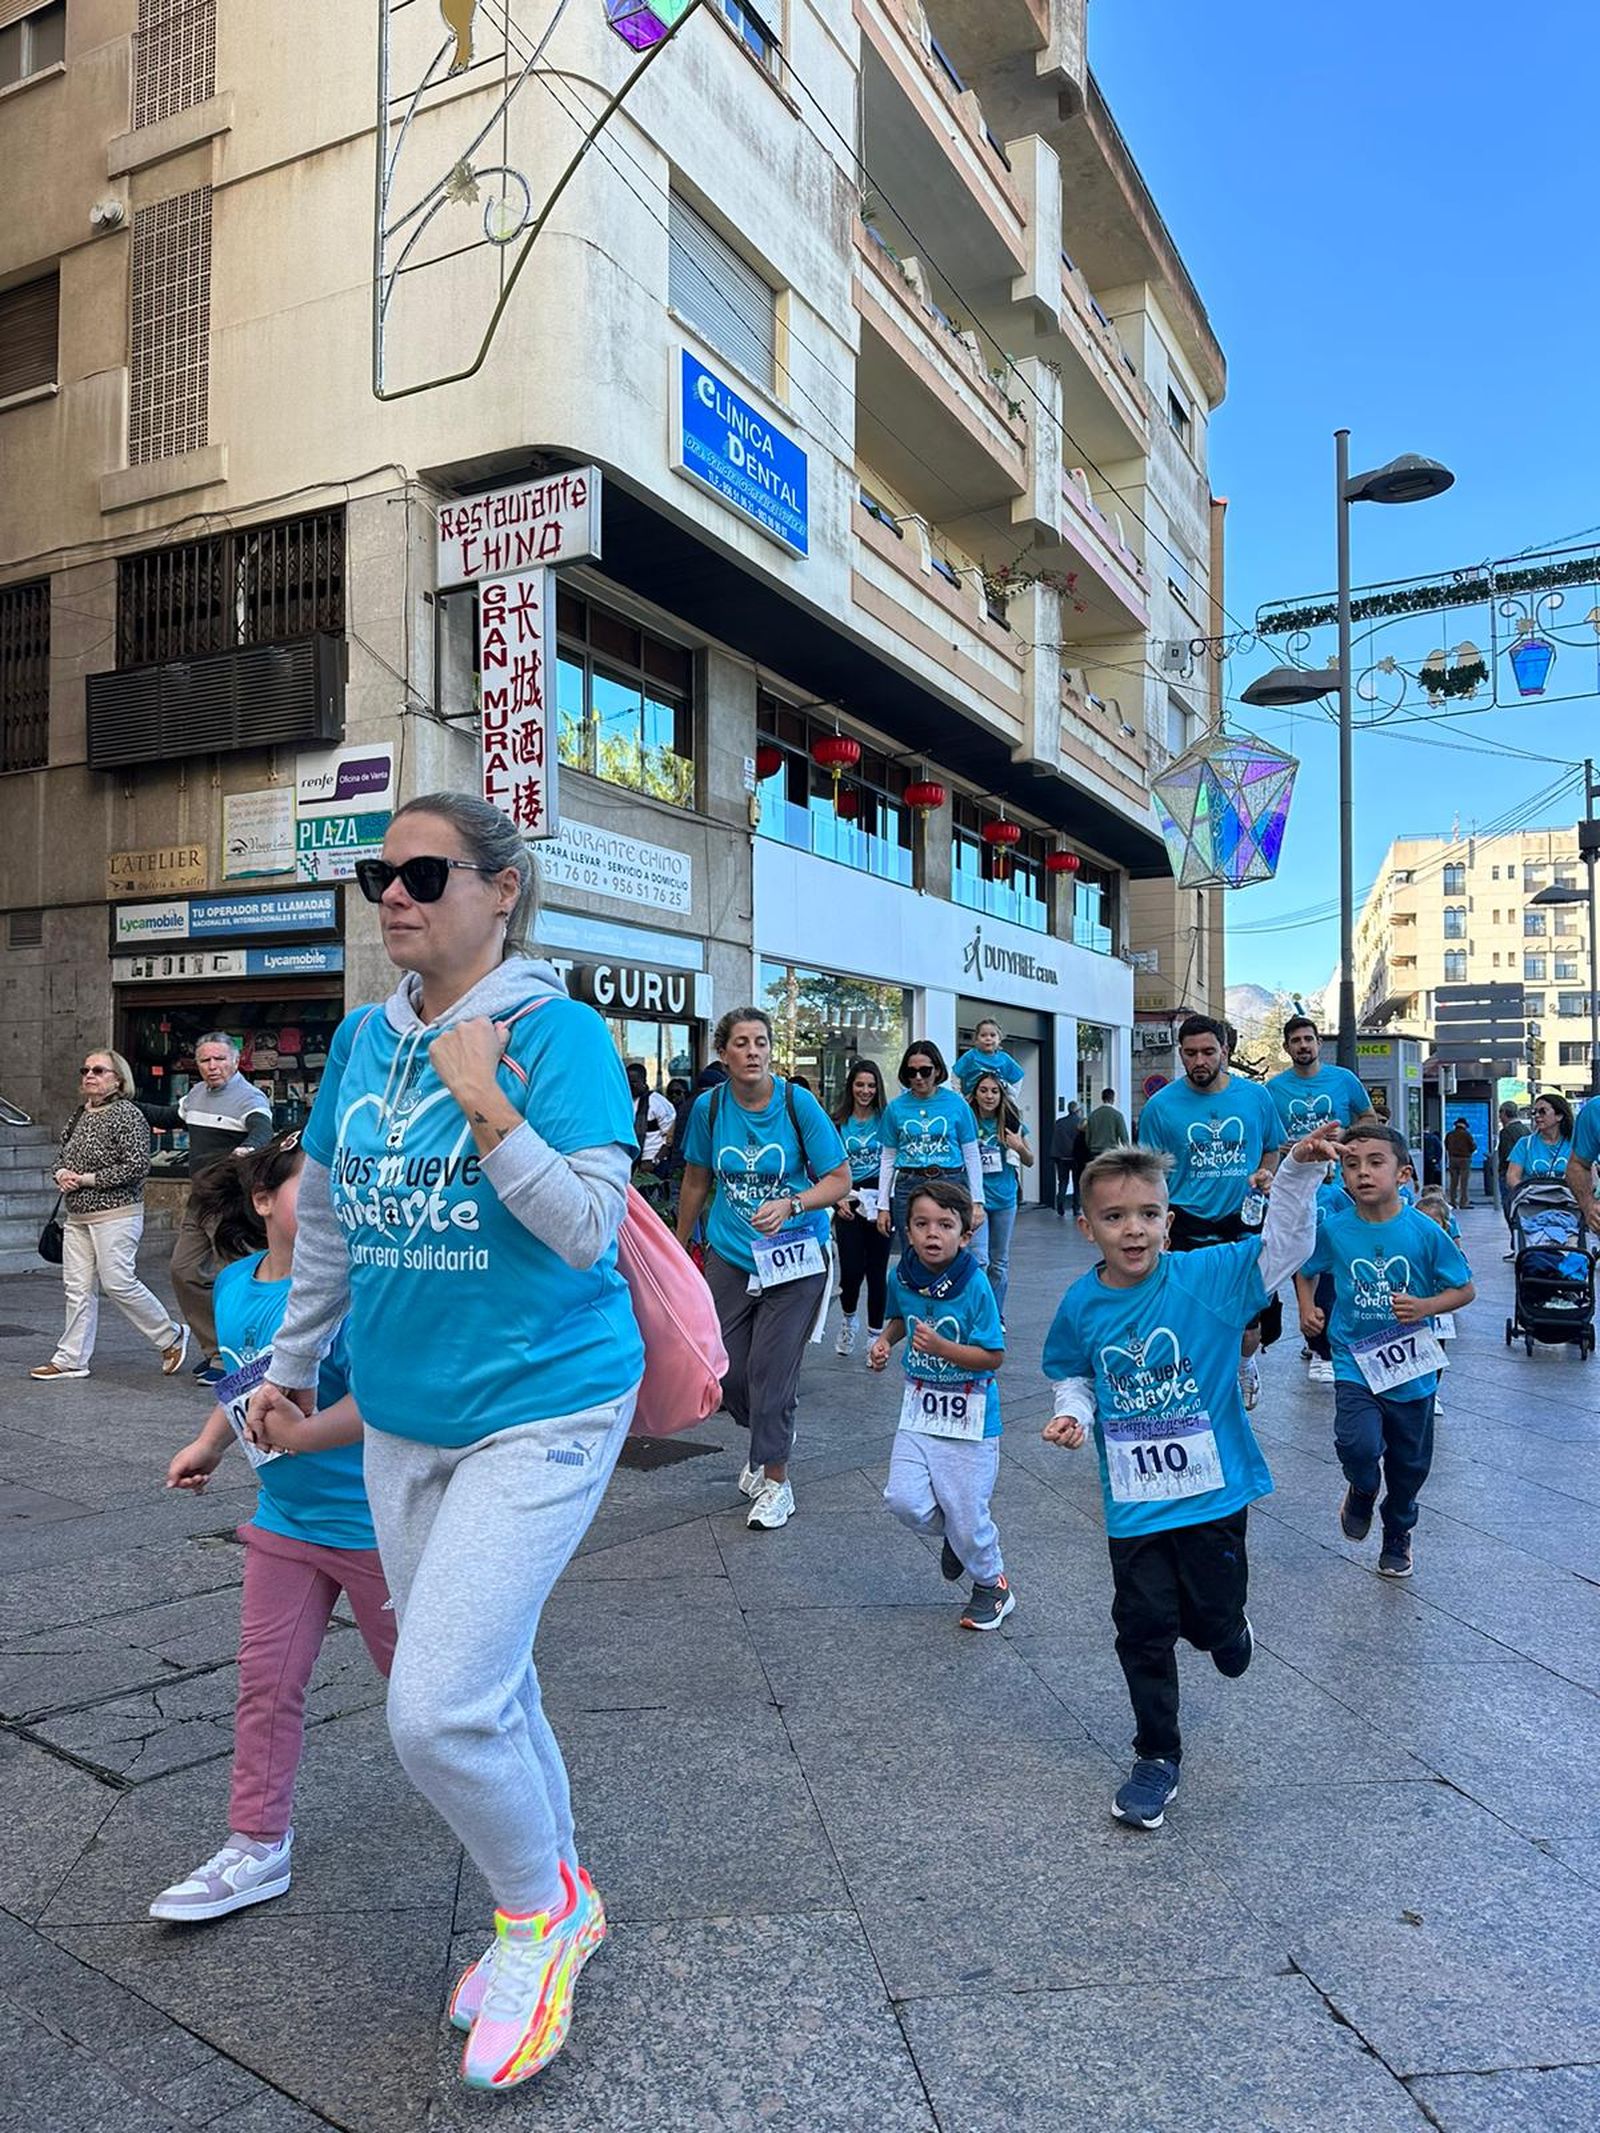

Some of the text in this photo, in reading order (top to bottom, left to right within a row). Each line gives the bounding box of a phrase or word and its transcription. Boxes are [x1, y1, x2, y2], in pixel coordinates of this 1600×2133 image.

[697, 374, 775, 460] CLÍNICA
[728, 431, 802, 514] DENTAL
[440, 476, 587, 542] Restaurante
[461, 521, 564, 577] CHINO
[482, 584, 508, 670] GRAN
[301, 773, 334, 790] renfe
[339, 770, 388, 785] Oficina de Venta
[299, 818, 359, 849] PLAZA
[558, 825, 682, 876] AURANTE CHINO
[544, 859, 682, 906] 51 76 02 956 51 76 25
[545, 844, 568, 860] PARA
[570, 851, 601, 868] LLEVAR
[607, 861, 642, 878] SERVICIO
[643, 870, 650, 881] A
[651, 872, 689, 892] DOMICILIO
[119, 908, 184, 932] Lycamobile
[192, 898, 332, 919] TU OPERADOR DE LLAMADAS
[298, 911, 332, 920] INTERNET
[264, 950, 327, 968] Lycamobile
[984, 943, 1036, 981] DUTYFREE
[593, 964, 686, 1014] GURU
[333, 1147, 376, 1186] Nos
[981, 1154, 993, 1165] 21
[403, 1243, 489, 1271] solidaria
[771, 1242, 806, 1268] 017
[1375, 1336, 1417, 1369] 107
[922, 1392, 967, 1419] 019
[545, 1448, 584, 1467] PUMA
[1131, 1442, 1189, 1475] 110
